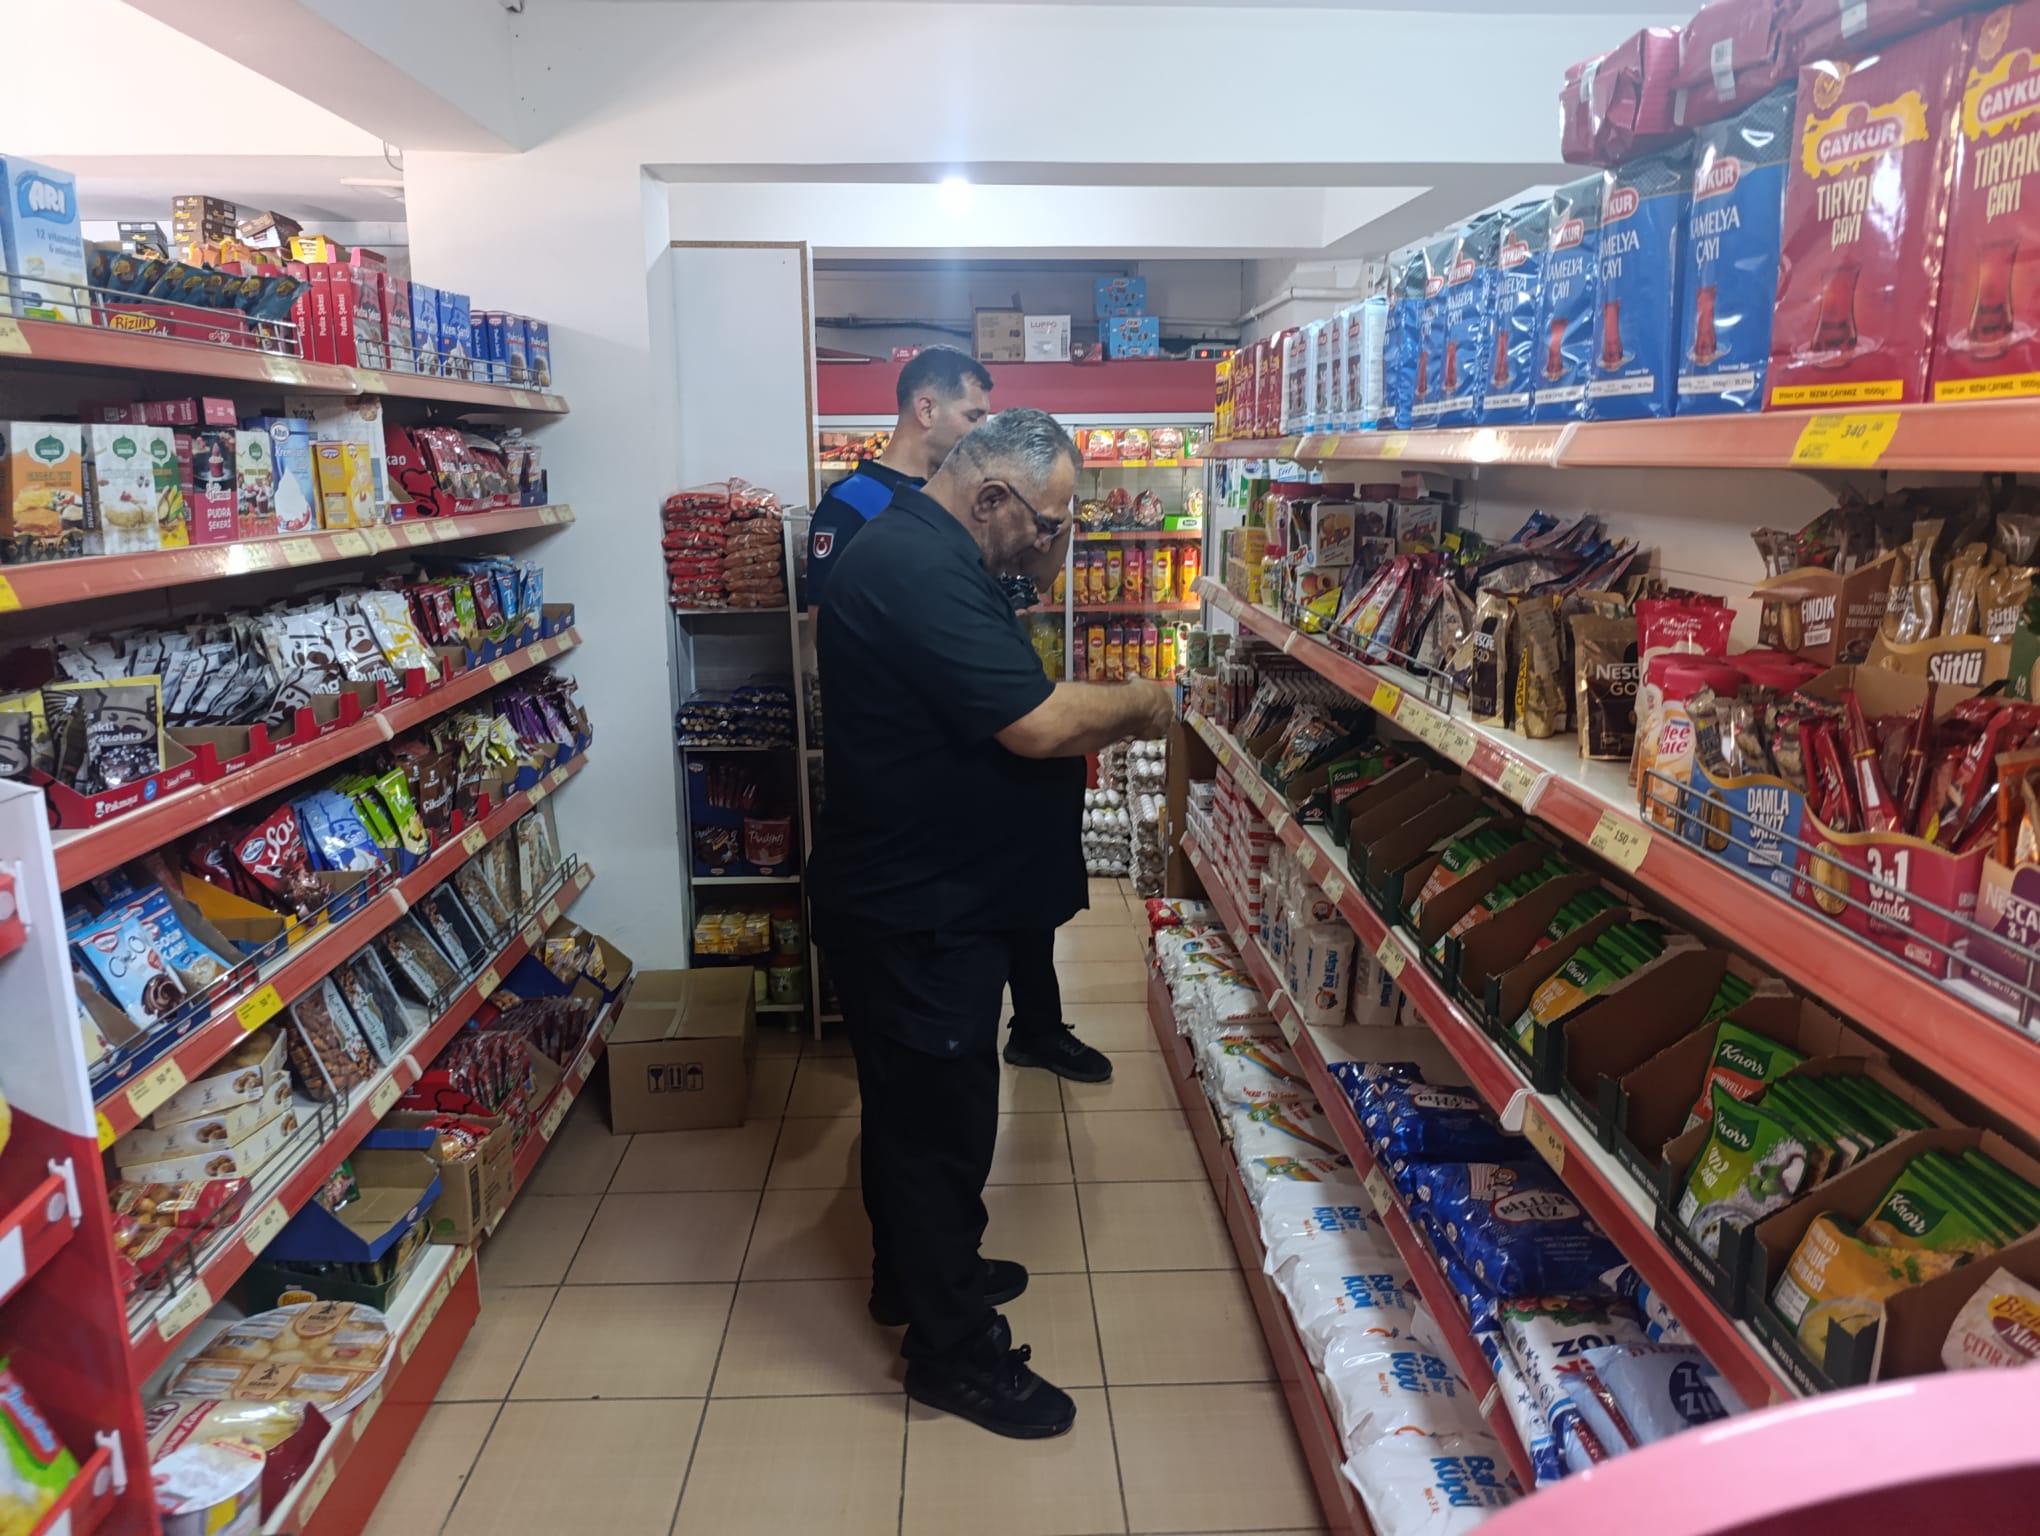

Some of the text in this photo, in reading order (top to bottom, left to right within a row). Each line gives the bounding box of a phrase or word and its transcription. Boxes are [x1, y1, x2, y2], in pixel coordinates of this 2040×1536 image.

[1981, 75, 2040, 122] ÇAYKU
[1819, 122, 1896, 161] ÇAYKUR
[1973, 131, 2040, 191] TIRYAK
[1986, 179, 2022, 224] ÇAYI
[1831, 213, 1863, 252] ÇAYI
[1696, 238, 1720, 267] ÇAYI
[1602, 258, 1622, 285] ÇAYI
[1552, 281, 1571, 305] ÇAYI
[115, 314, 152, 330] Bizim
[1842, 424, 1867, 439] 340
[386, 455, 407, 466] kao
[207, 507, 232, 519] PUDRA
[1801, 595, 1837, 623] FINDIK
[1596, 664, 1640, 682] NESC
[1929, 651, 1983, 685] Sütlü
[1610, 683, 1639, 696] GO
[1747, 787, 1790, 816] DAMLA
[1613, 829, 1629, 846] 150
[1869, 899, 1911, 922] arada
[1721, 1042, 1765, 1077] Knorr
[1887, 1191, 1926, 1235] Knorr
[1963, 1331, 2003, 1367] ÇITIR
[1390, 1351, 1424, 1393] Küpü
[1430, 1455, 1504, 1508] Bal Küpü
